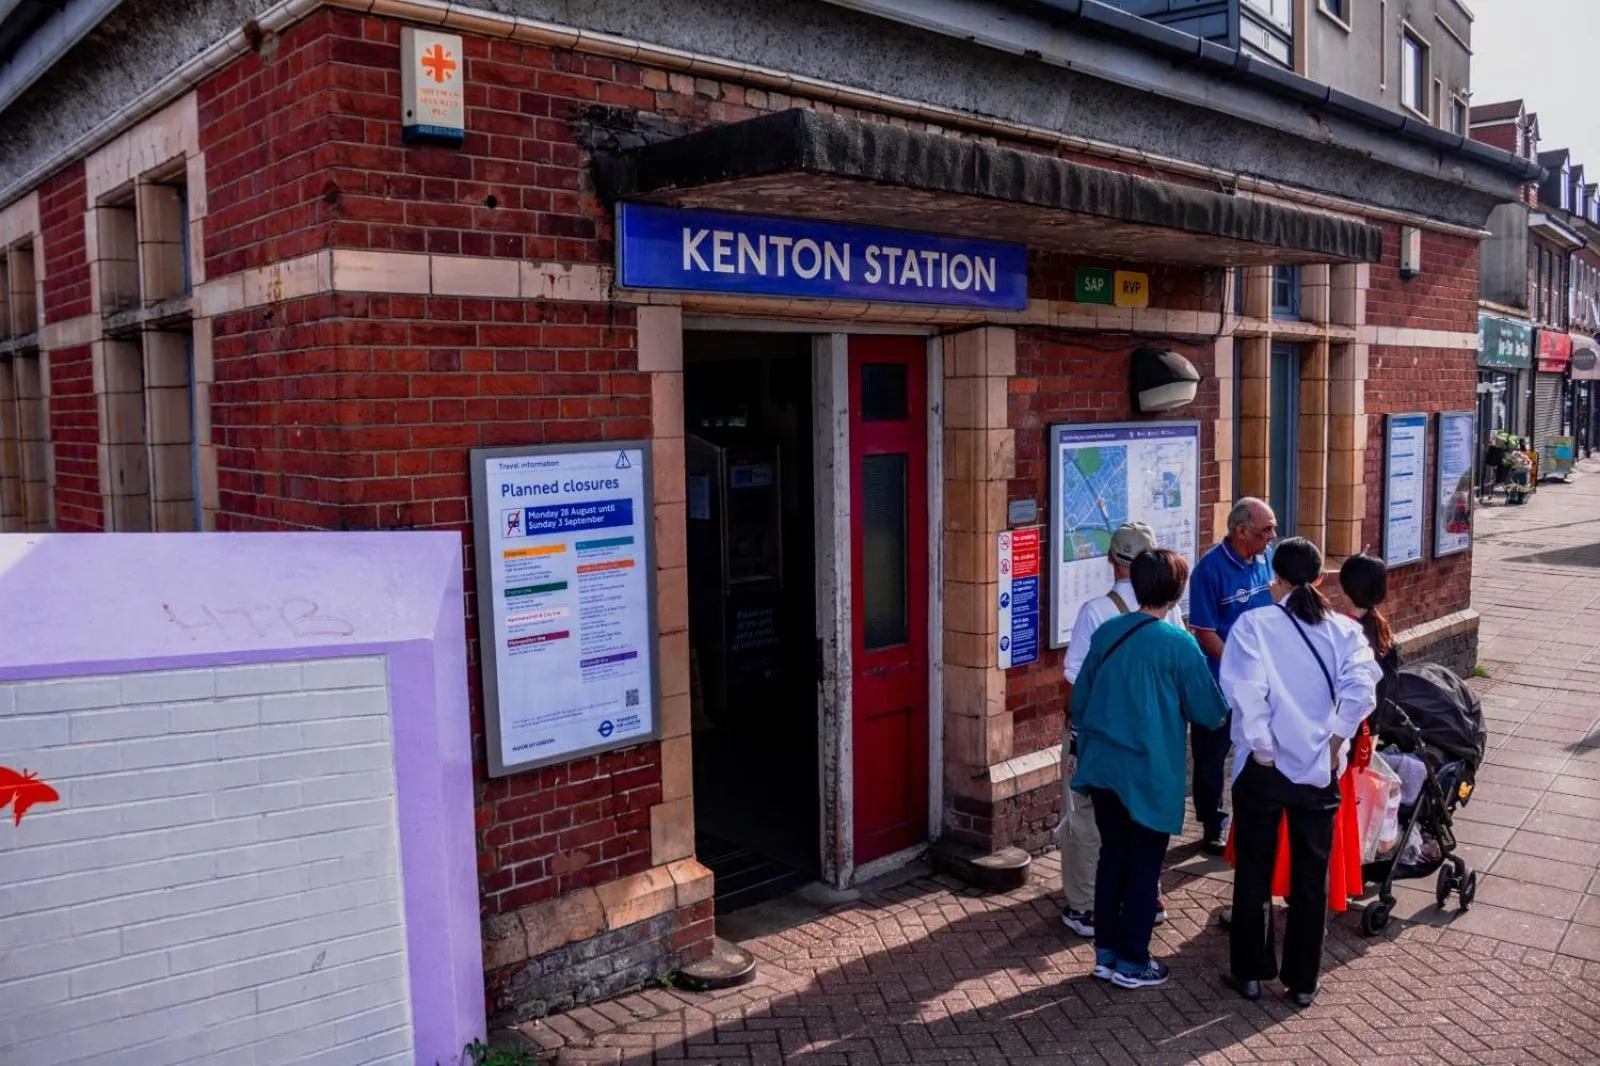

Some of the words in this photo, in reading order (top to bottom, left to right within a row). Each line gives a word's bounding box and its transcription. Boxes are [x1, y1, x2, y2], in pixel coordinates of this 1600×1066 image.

[682, 227, 850, 282] KENTON
[864, 245, 996, 292] STATION
[1084, 276, 1104, 292] SAP
[498, 462, 520, 470] Travel
[521, 460, 560, 469] information
[501, 481, 559, 498] Planned
[563, 478, 620, 492] closures
[528, 509, 559, 520] Monday
[571, 506, 597, 516] August
[598, 503, 616, 513] until
[528, 520, 557, 531] Sunday
[558, 518, 563, 527] 3
[564, 515, 605, 528] September
